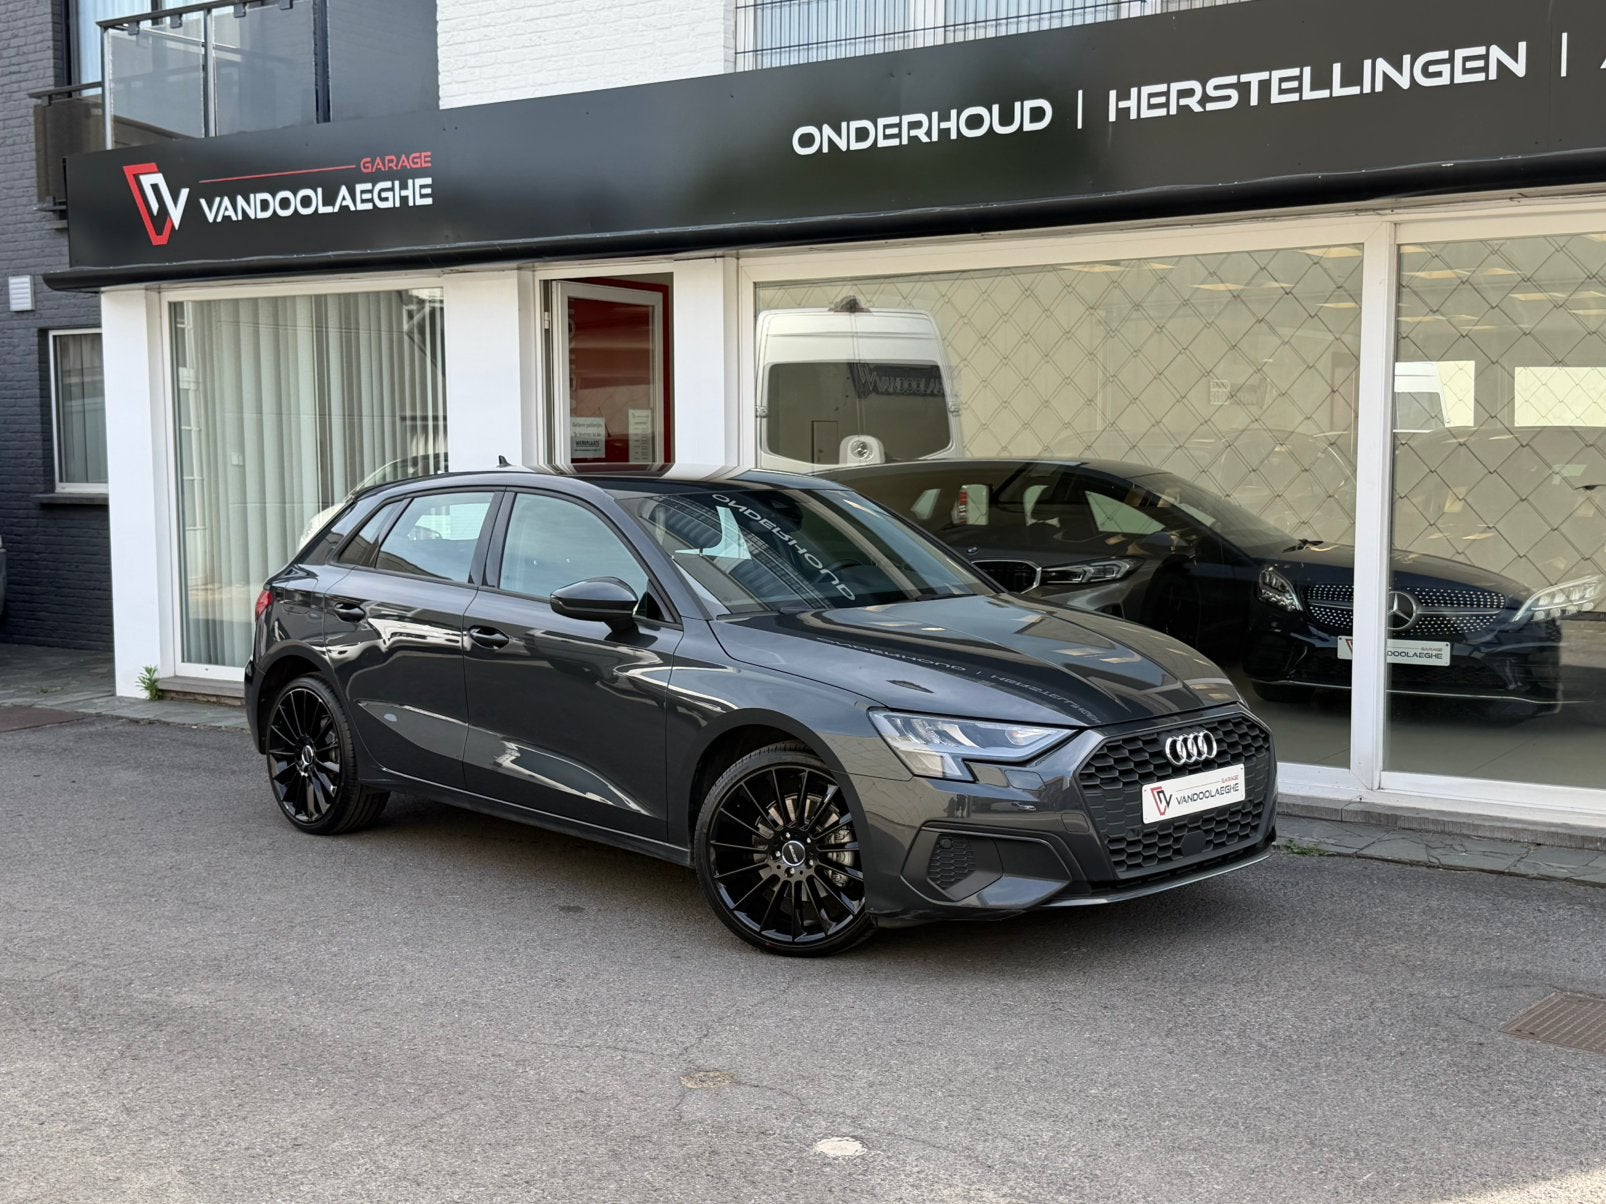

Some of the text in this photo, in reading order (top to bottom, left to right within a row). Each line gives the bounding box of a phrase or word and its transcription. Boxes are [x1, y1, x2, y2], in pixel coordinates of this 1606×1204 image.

[792, 41, 1527, 156] ONDERHOUD HERSTELLINGEN
[360, 152, 432, 173] GARAGE
[199, 177, 433, 223] VANDOOLAEGHE
[1386, 650, 1443, 660] DOOLAEGHE
[1175, 782, 1240, 806] VANDOOLAEGHE
